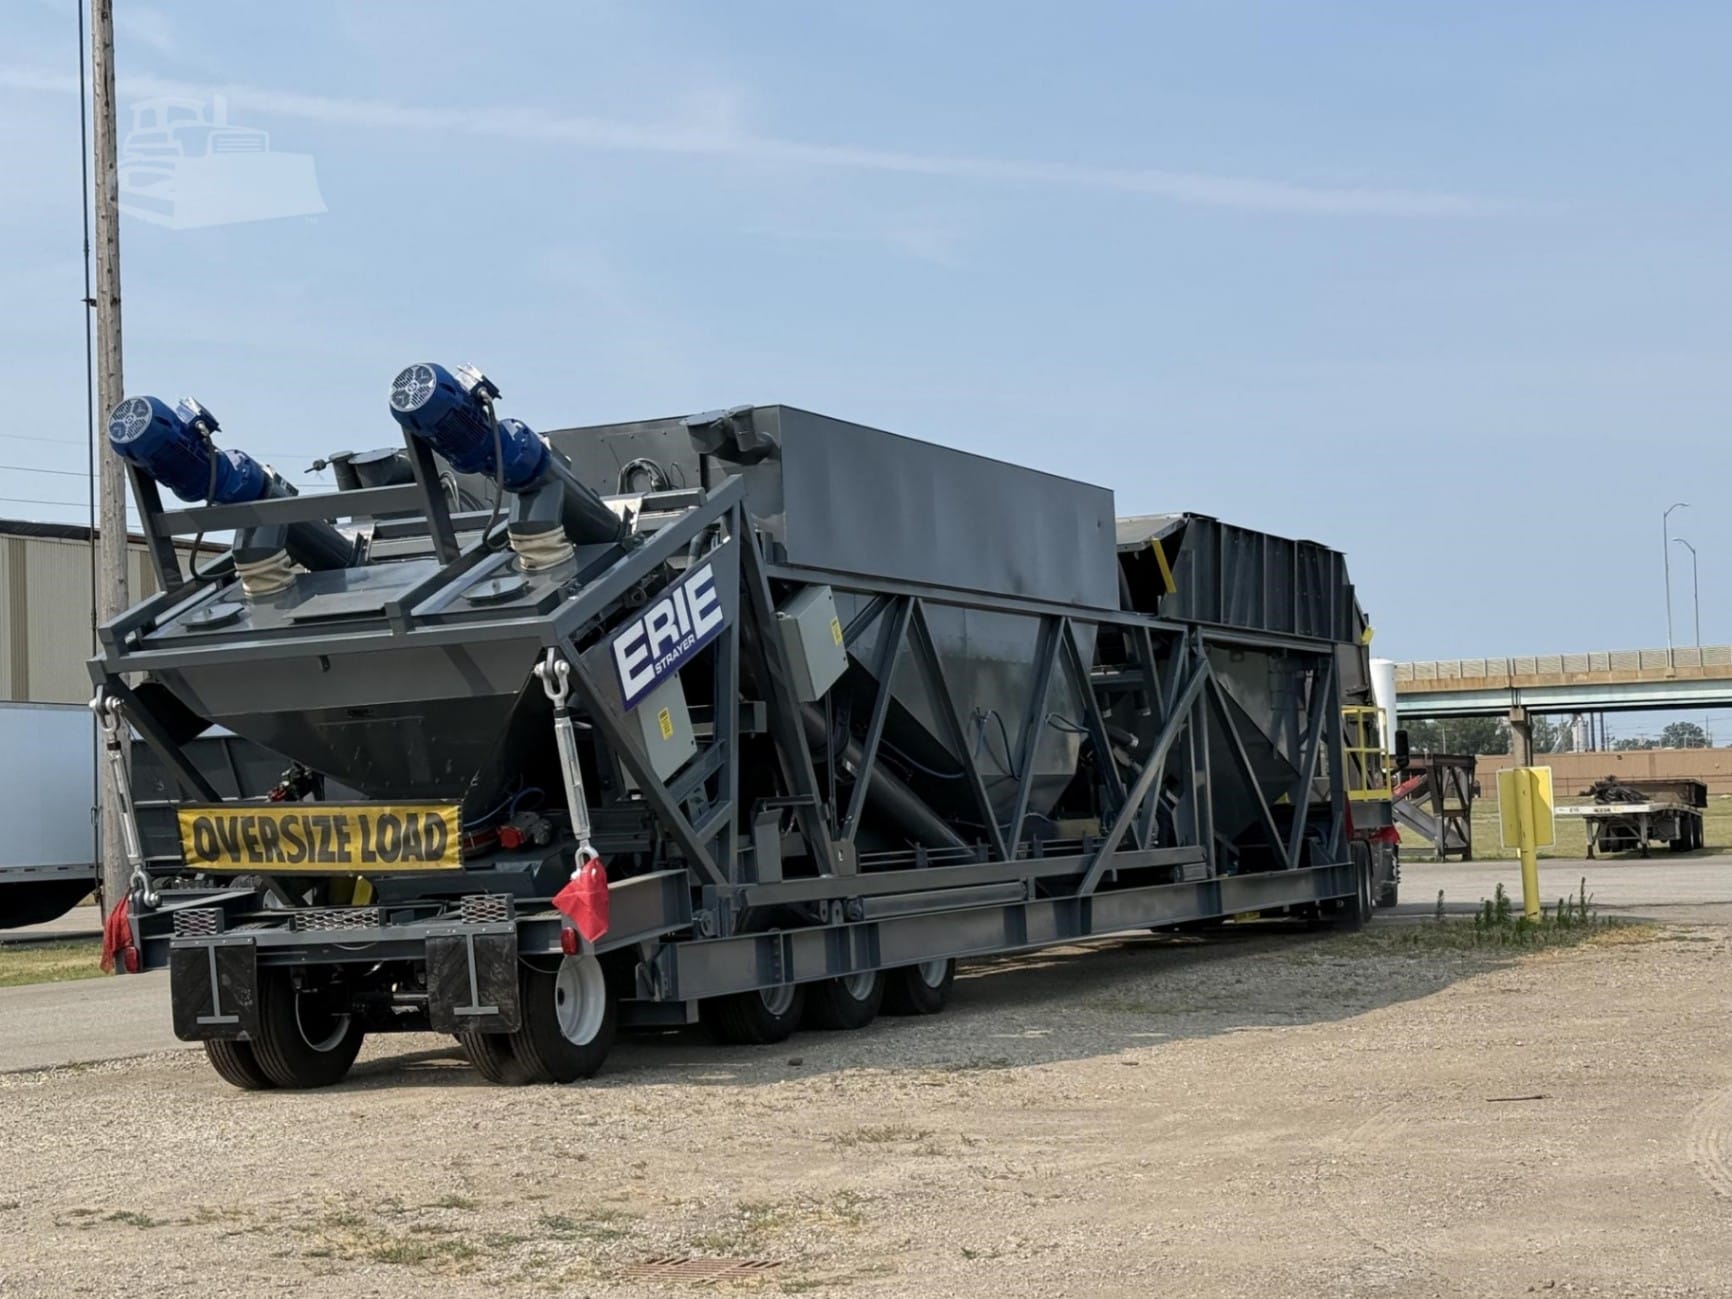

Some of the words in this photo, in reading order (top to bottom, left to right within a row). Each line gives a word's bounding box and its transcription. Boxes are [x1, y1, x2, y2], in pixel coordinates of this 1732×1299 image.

[613, 563, 723, 701] ERIE
[655, 634, 696, 675] STRAYER
[192, 814, 352, 864] OVERSIZE
[358, 812, 448, 864] LOAD
